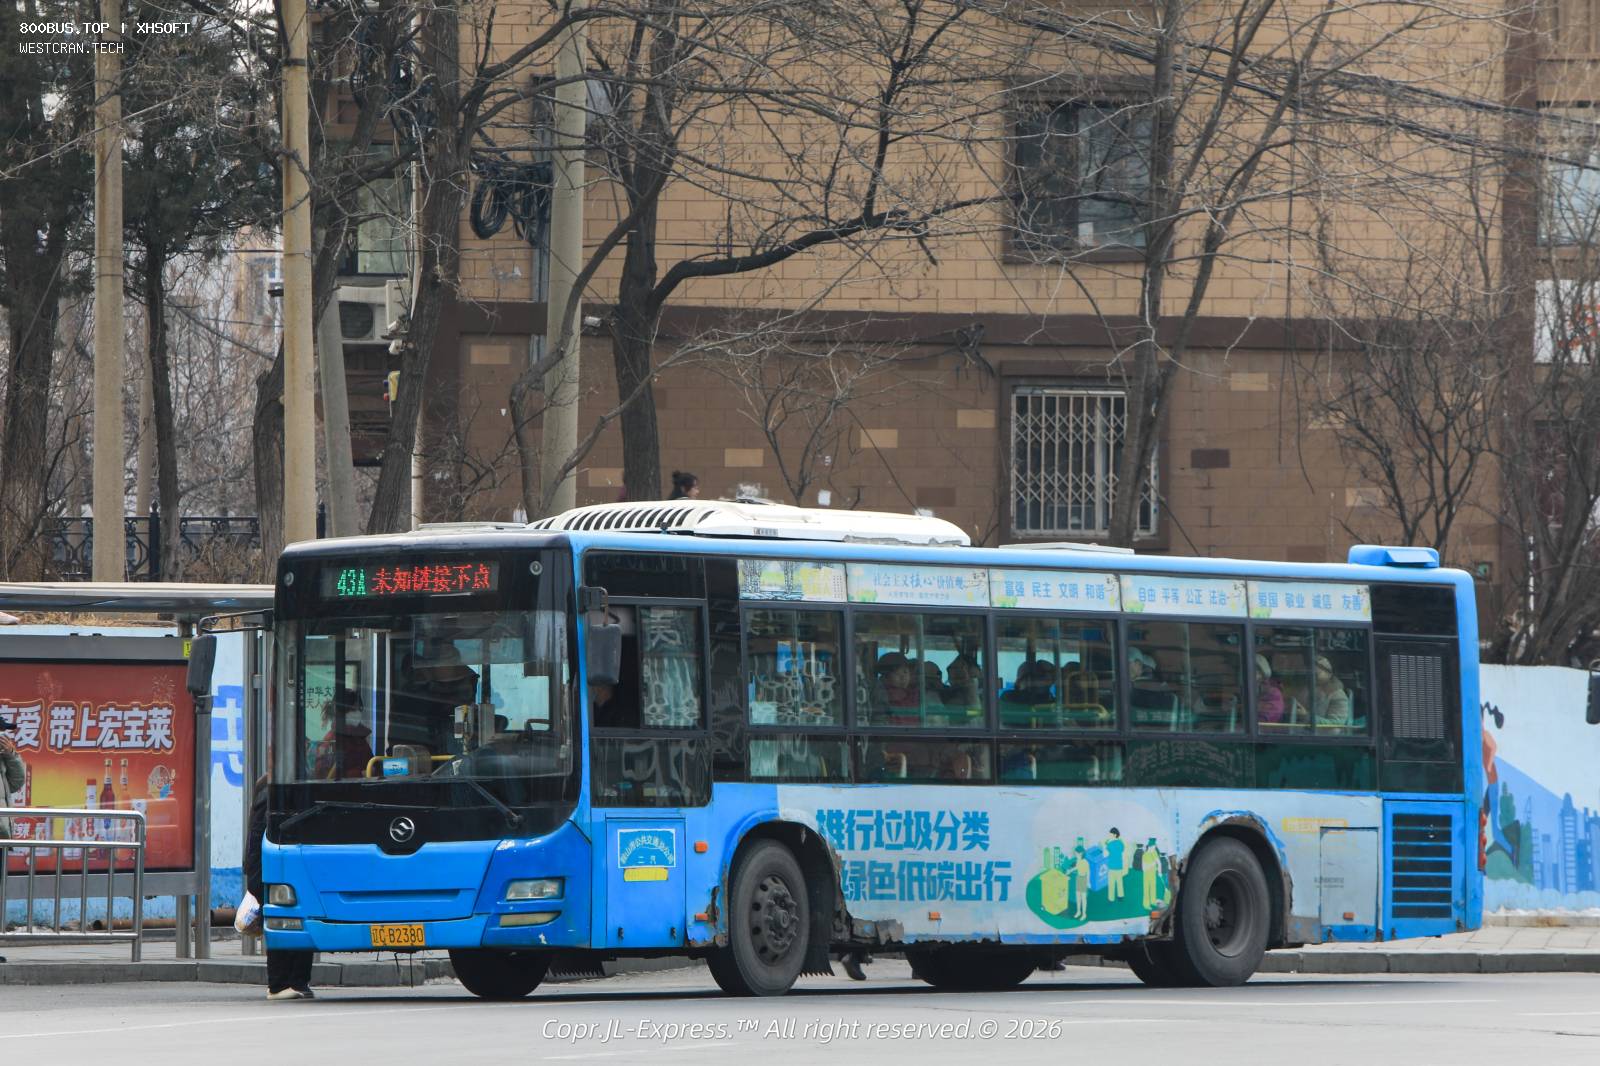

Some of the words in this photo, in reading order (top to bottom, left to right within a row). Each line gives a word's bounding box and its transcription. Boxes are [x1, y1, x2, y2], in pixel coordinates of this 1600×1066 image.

[337, 568, 367, 597] 43A
[1004, 579, 1025, 597] 富强
[1031, 580, 1053, 598] 民主
[1058, 582, 1079, 599] 文明
[1085, 584, 1105, 600] 和谐
[1137, 587, 1156, 603] 自由
[1161, 588, 1180, 604] 平等
[1185, 589, 1204, 605] 公正
[306, 685, 336, 698] 中华文
[49, 705, 173, 750] 带上宏宝莱
[816, 809, 990, 852] 推行垃圾分类
[840, 860, 1012, 902] 绿色低碳出行
